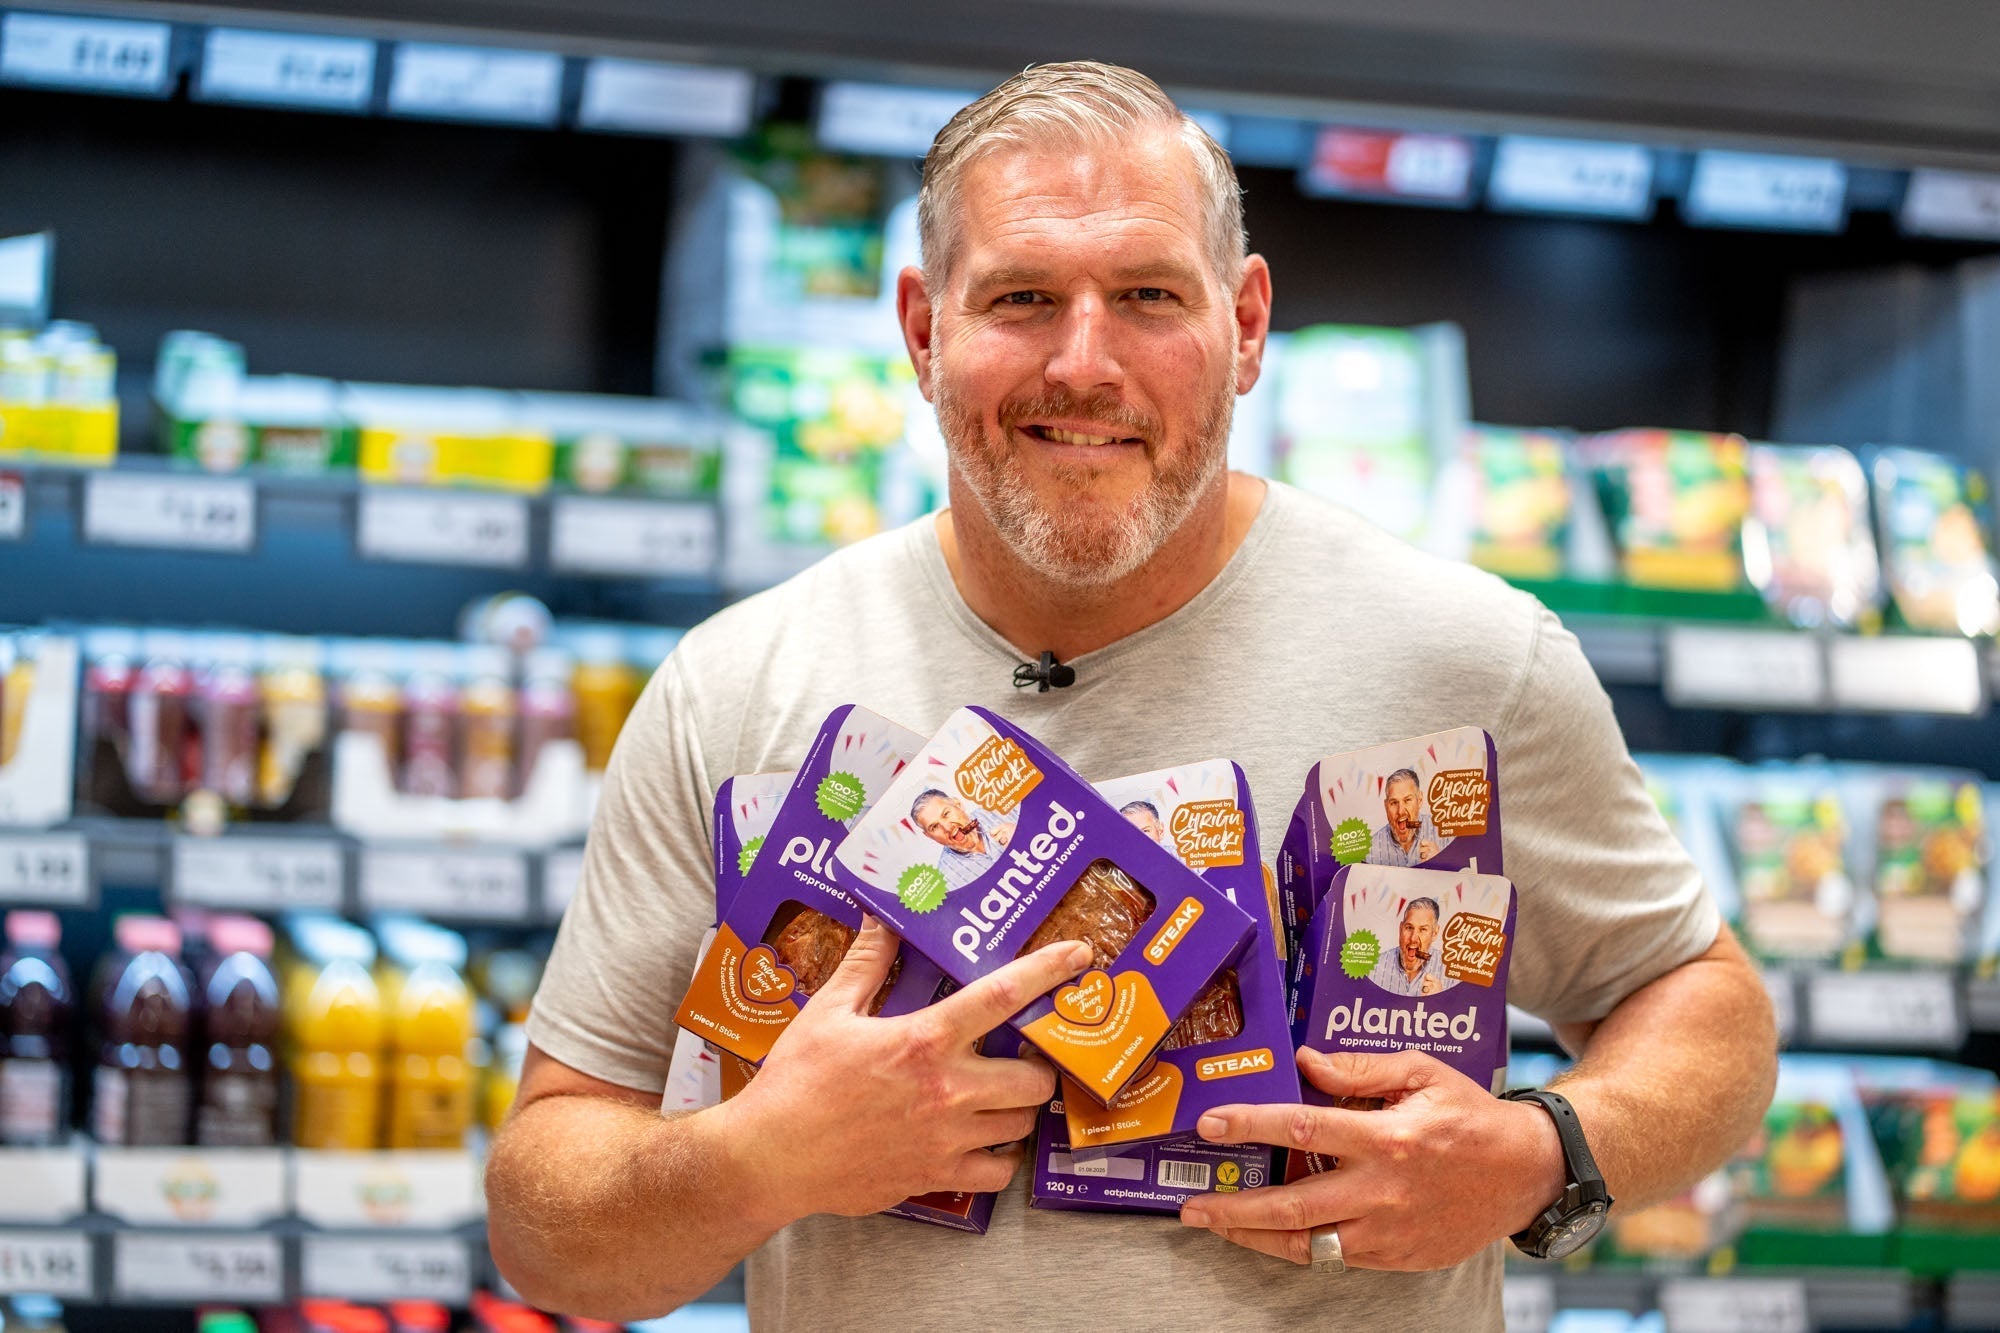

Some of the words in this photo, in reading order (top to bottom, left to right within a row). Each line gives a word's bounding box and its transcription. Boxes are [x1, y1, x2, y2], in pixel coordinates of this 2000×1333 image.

[830, 780, 860, 800] 100%
[1337, 829, 1365, 841] 100%
[1190, 850, 1241, 858] Schwingerkönig
[794, 870, 845, 900] approved
[904, 869, 929, 897] 100%
[952, 800, 1085, 964] planted.
[985, 905, 1026, 951] approved
[1024, 891, 1038, 907] by
[1036, 863, 1060, 891] meat
[1056, 833, 1084, 866] lovers
[1150, 903, 1199, 958] STEAK
[722, 948, 731, 965] Ohne
[1349, 942, 1374, 951] 100%
[721, 967, 730, 1007] Zusatzstoffe
[730, 956, 736, 965] No
[736, 1001, 750, 1011] High
[1126, 982, 1136, 1015] Proteinen
[732, 1009, 748, 1021] Reich
[1057, 1024, 1066, 1032] No
[1103, 1021, 1116, 1034] High
[1114, 1013, 1121, 1022] in
[1118, 989, 1128, 1014] protein
[1123, 1016, 1130, 1024] an
[1325, 997, 1480, 1042] planted.
[694, 1013, 714, 1028] piece
[719, 1025, 741, 1041] Stück
[1048, 1029, 1064, 1040] Ohne
[1111, 1024, 1125, 1040] Reich
[1065, 1037, 1108, 1046] Zusatzstoffe
[1340, 1037, 1388, 1048] approved
[1390, 1040, 1403, 1050] by
[1405, 1042, 1432, 1051] meat
[1433, 1043, 1463, 1053] lovers
[1108, 1058, 1124, 1081] piece
[1125, 1035, 1144, 1056] Stück
[1203, 1054, 1268, 1076] STEAK
[1140, 1076, 1160, 1093] protein
[1145, 1077, 1172, 1099] Proteinen
[1087, 1124, 1110, 1135] piece
[1117, 1120, 1141, 1131] Stück
[1046, 1181, 1065, 1191] 120
[1066, 1184, 1074, 1194] g
[1104, 1188, 1176, 1202] eatplanted.com
